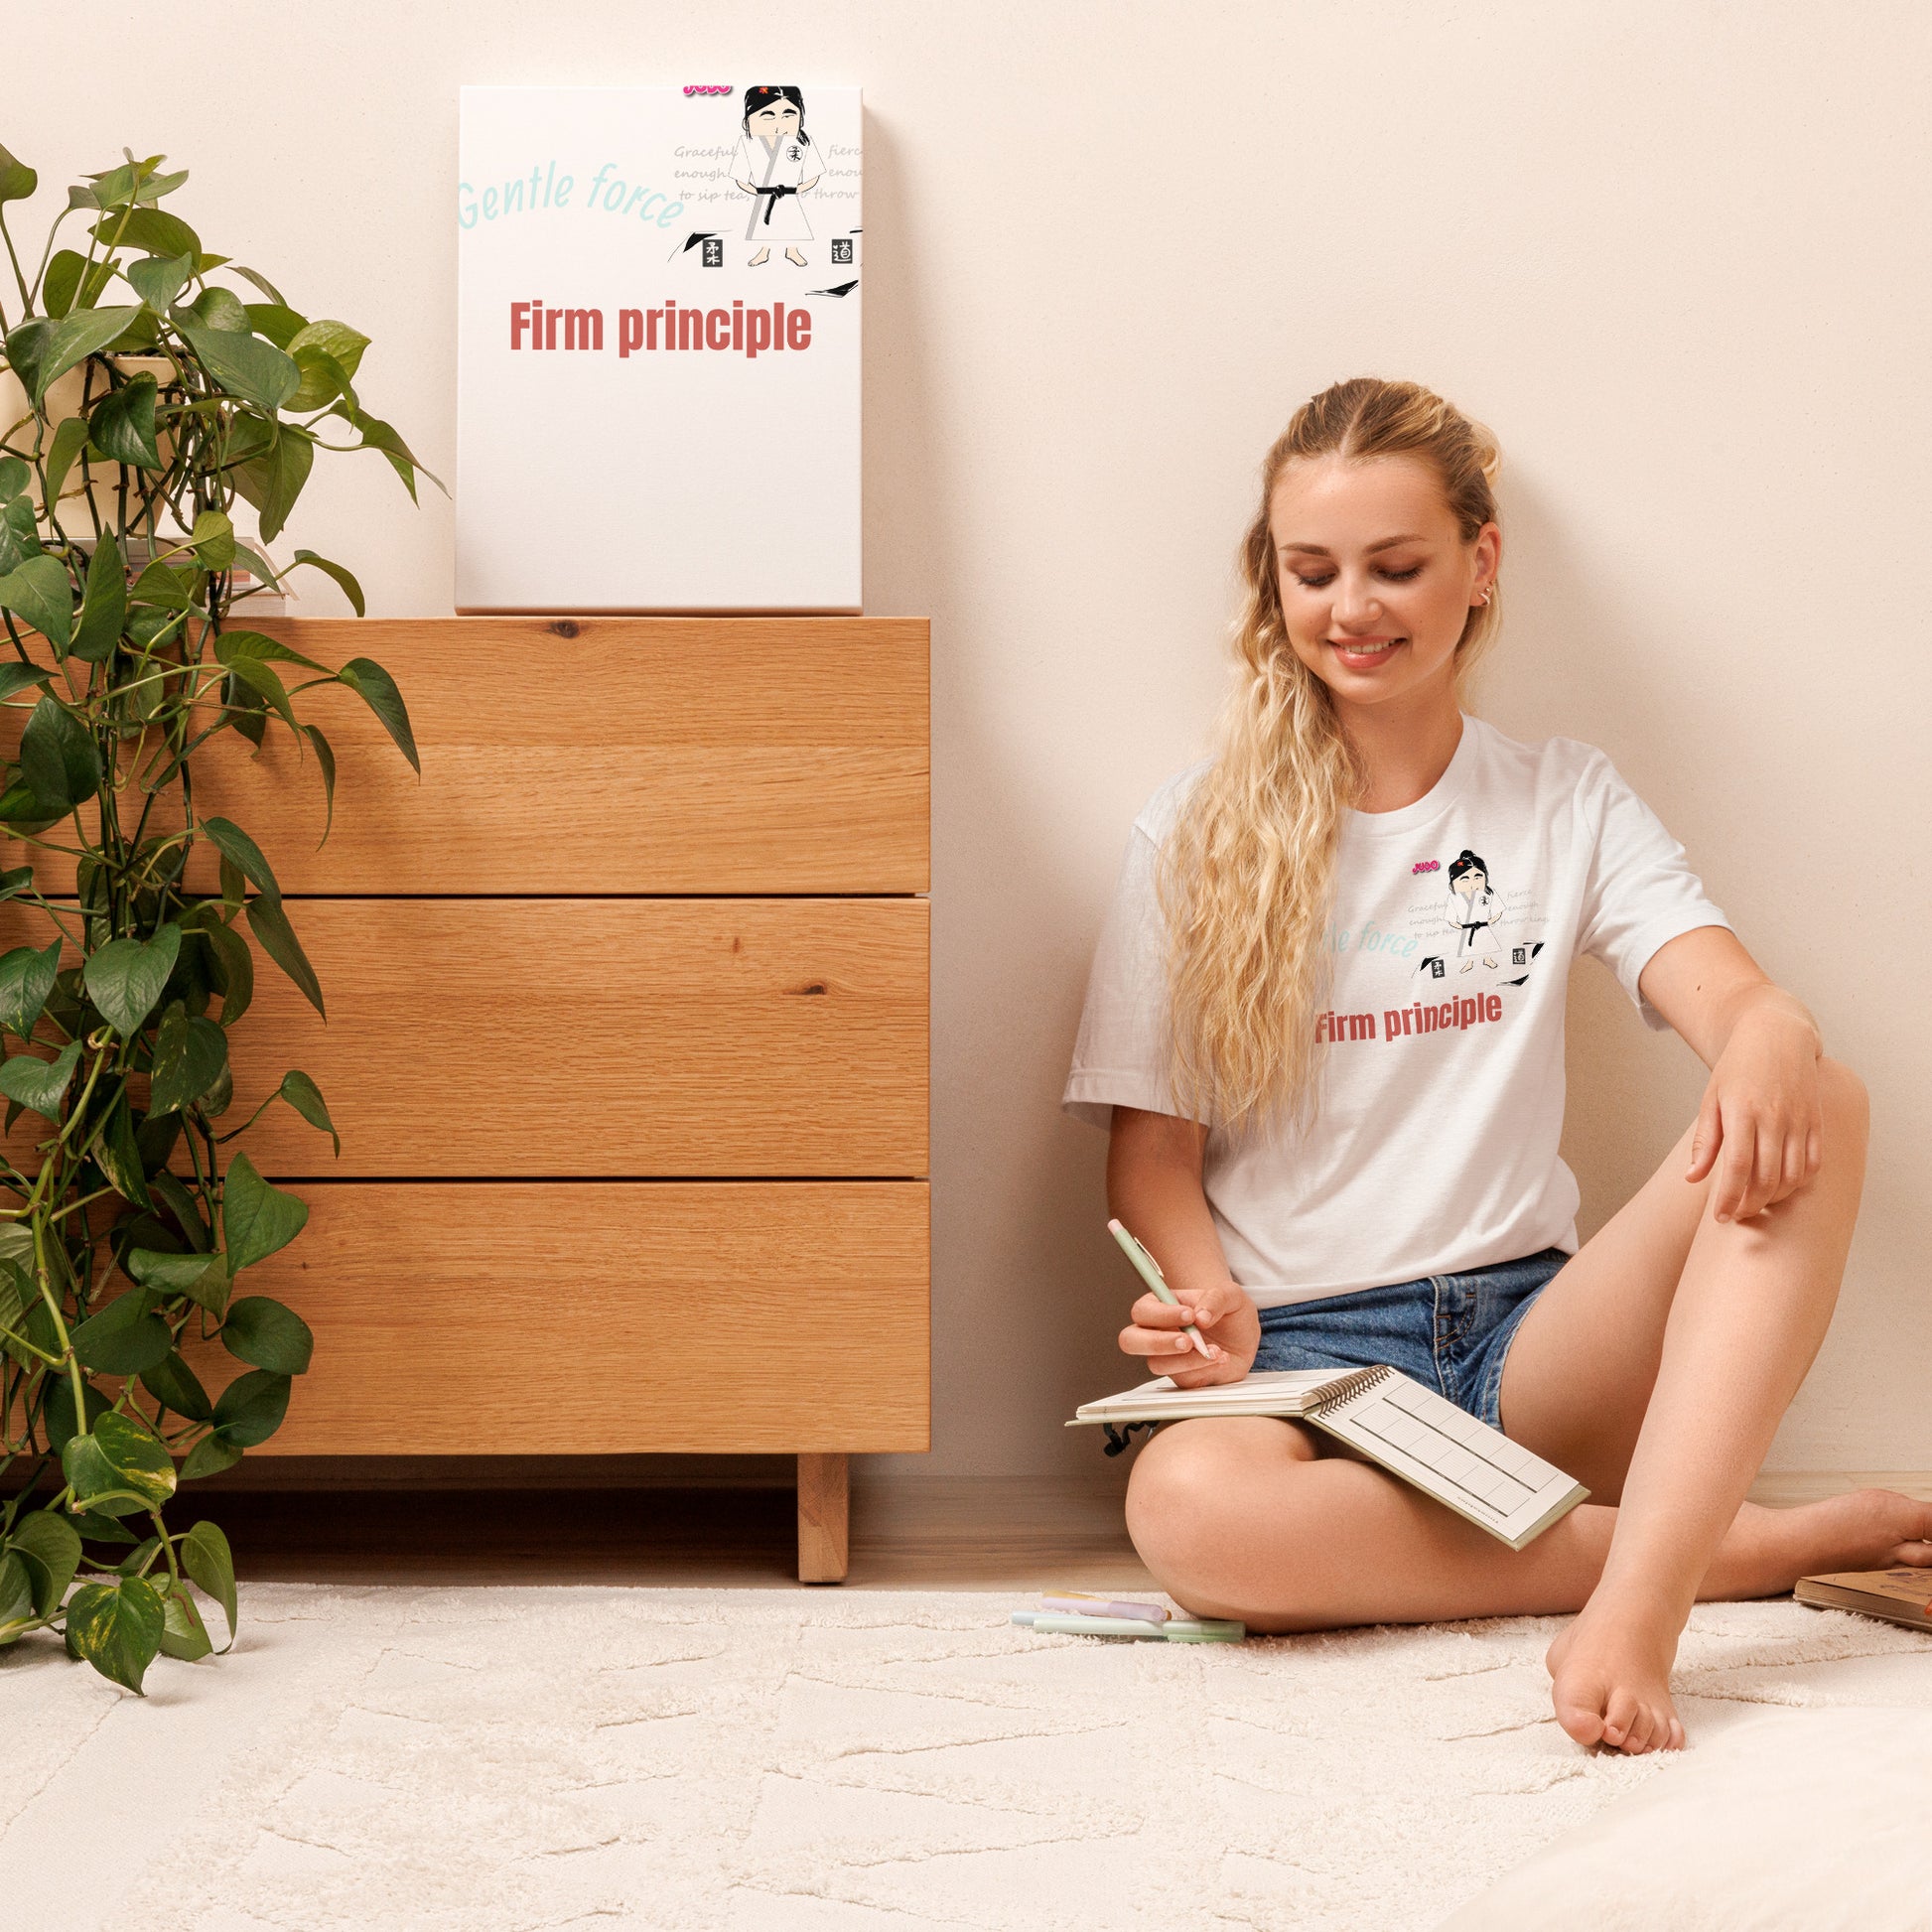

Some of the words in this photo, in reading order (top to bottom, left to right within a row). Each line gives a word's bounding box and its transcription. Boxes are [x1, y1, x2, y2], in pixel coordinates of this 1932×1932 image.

[674, 145, 739, 160] Graceful
[674, 168, 728, 182] enough
[459, 160, 575, 229] Gentle
[587, 163, 685, 228] force
[679, 191, 695, 201] to
[698, 189, 722, 203] sip
[814, 188, 860, 199] throw
[832, 240, 852, 263] 道
[510, 300, 604, 350] Firm
[619, 300, 812, 358] principle
[1412, 860, 1440, 875] JUDO
[1358, 920, 1418, 958] force
[1314, 1011, 1376, 1044] Firm
[1384, 992, 1503, 1042] principle
